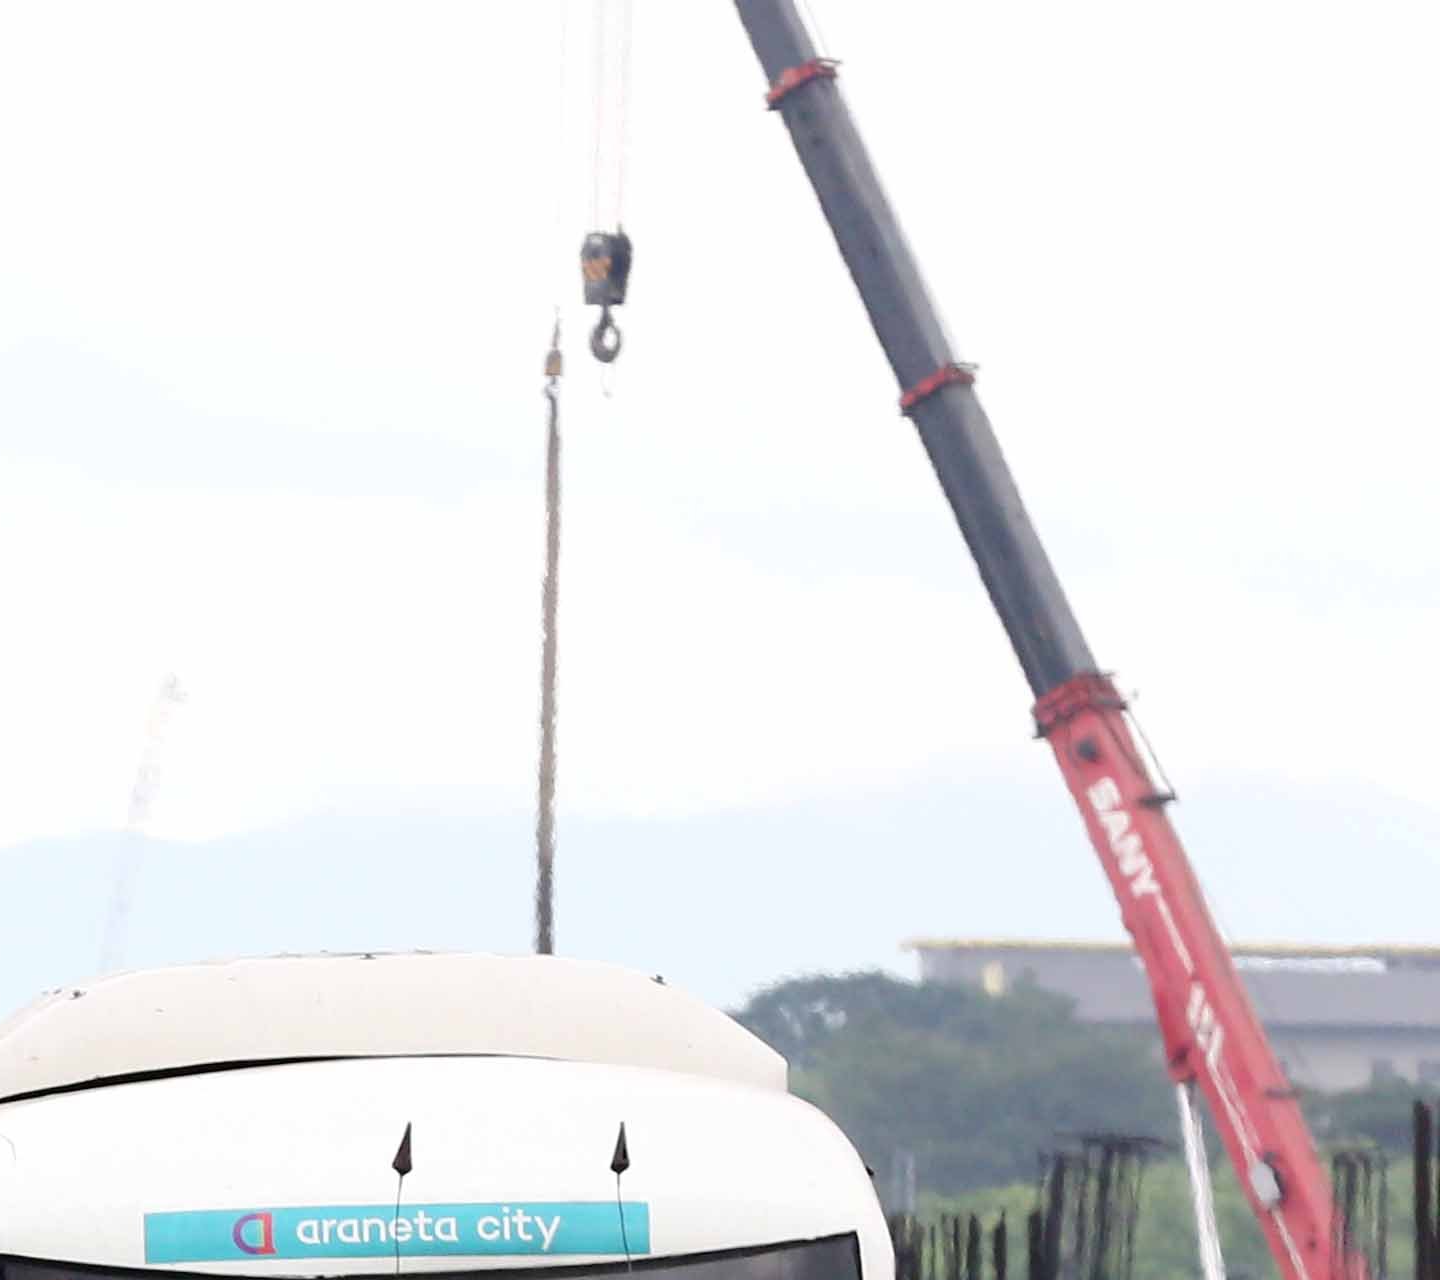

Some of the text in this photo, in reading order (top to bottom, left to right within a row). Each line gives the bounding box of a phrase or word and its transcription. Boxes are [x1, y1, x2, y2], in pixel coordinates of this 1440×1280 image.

[1087, 776, 1161, 898] SANY
[296, 1206, 561, 1249] araneta city
